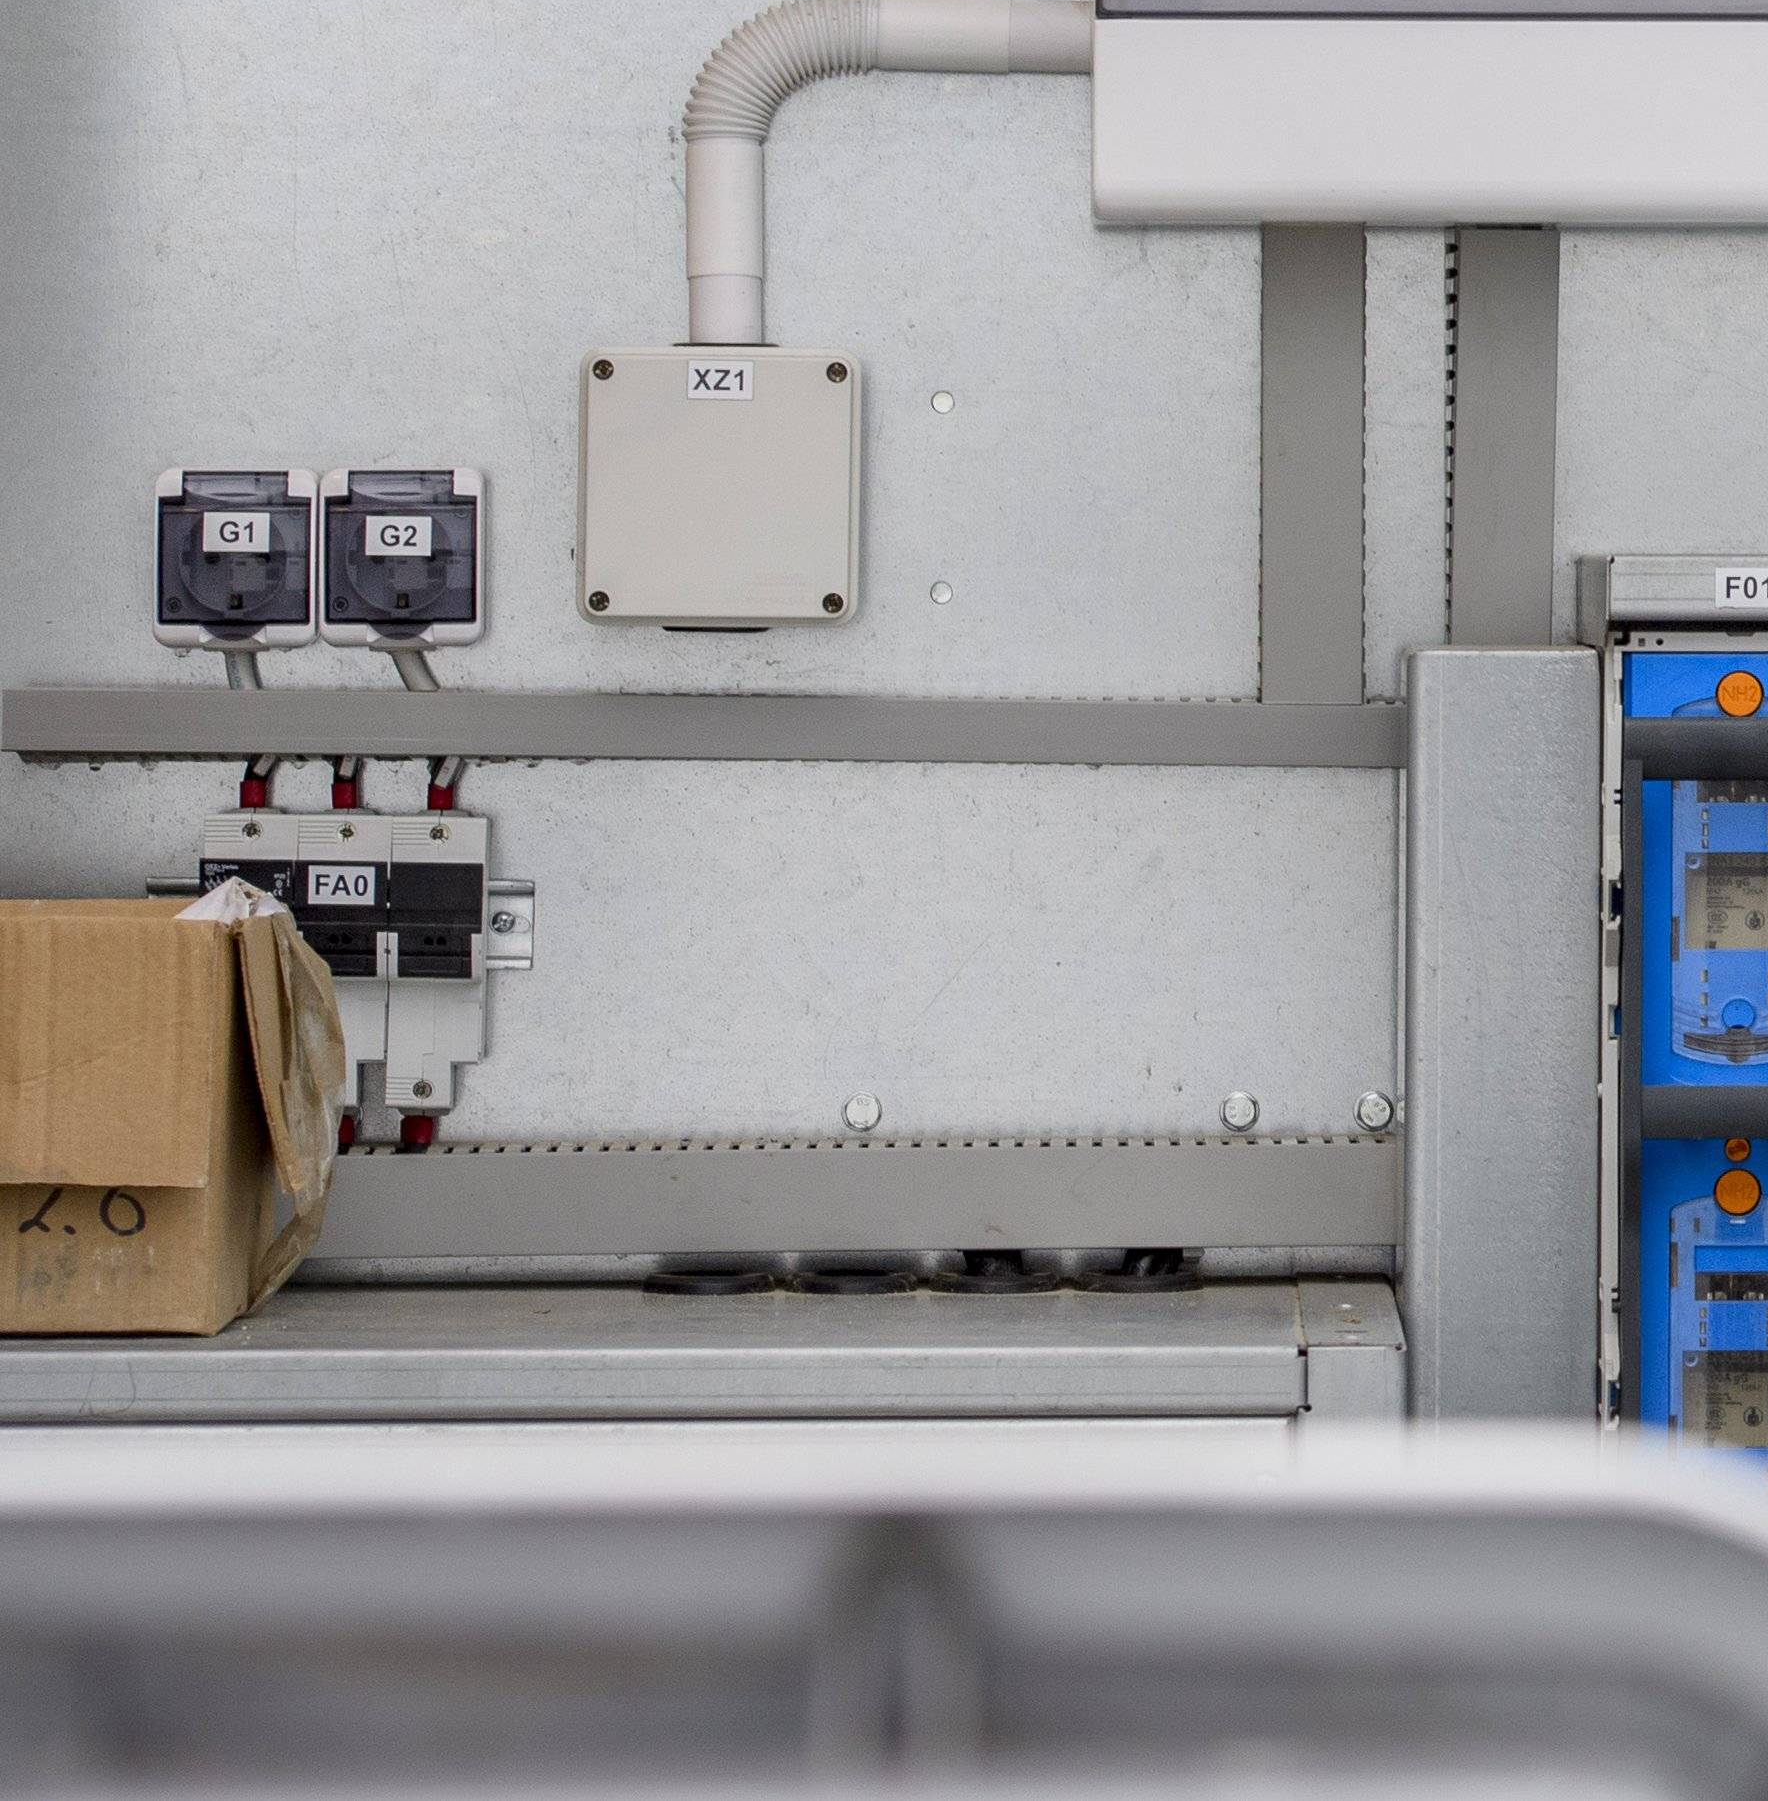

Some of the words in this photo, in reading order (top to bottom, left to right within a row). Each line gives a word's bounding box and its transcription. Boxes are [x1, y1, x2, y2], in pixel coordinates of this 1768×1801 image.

[694, 367, 747, 395] XZ1
[218, 521, 257, 547] G1
[379, 523, 420, 549] G2
[1722, 684, 1759, 704] NH2
[315, 874, 368, 896] FA0
